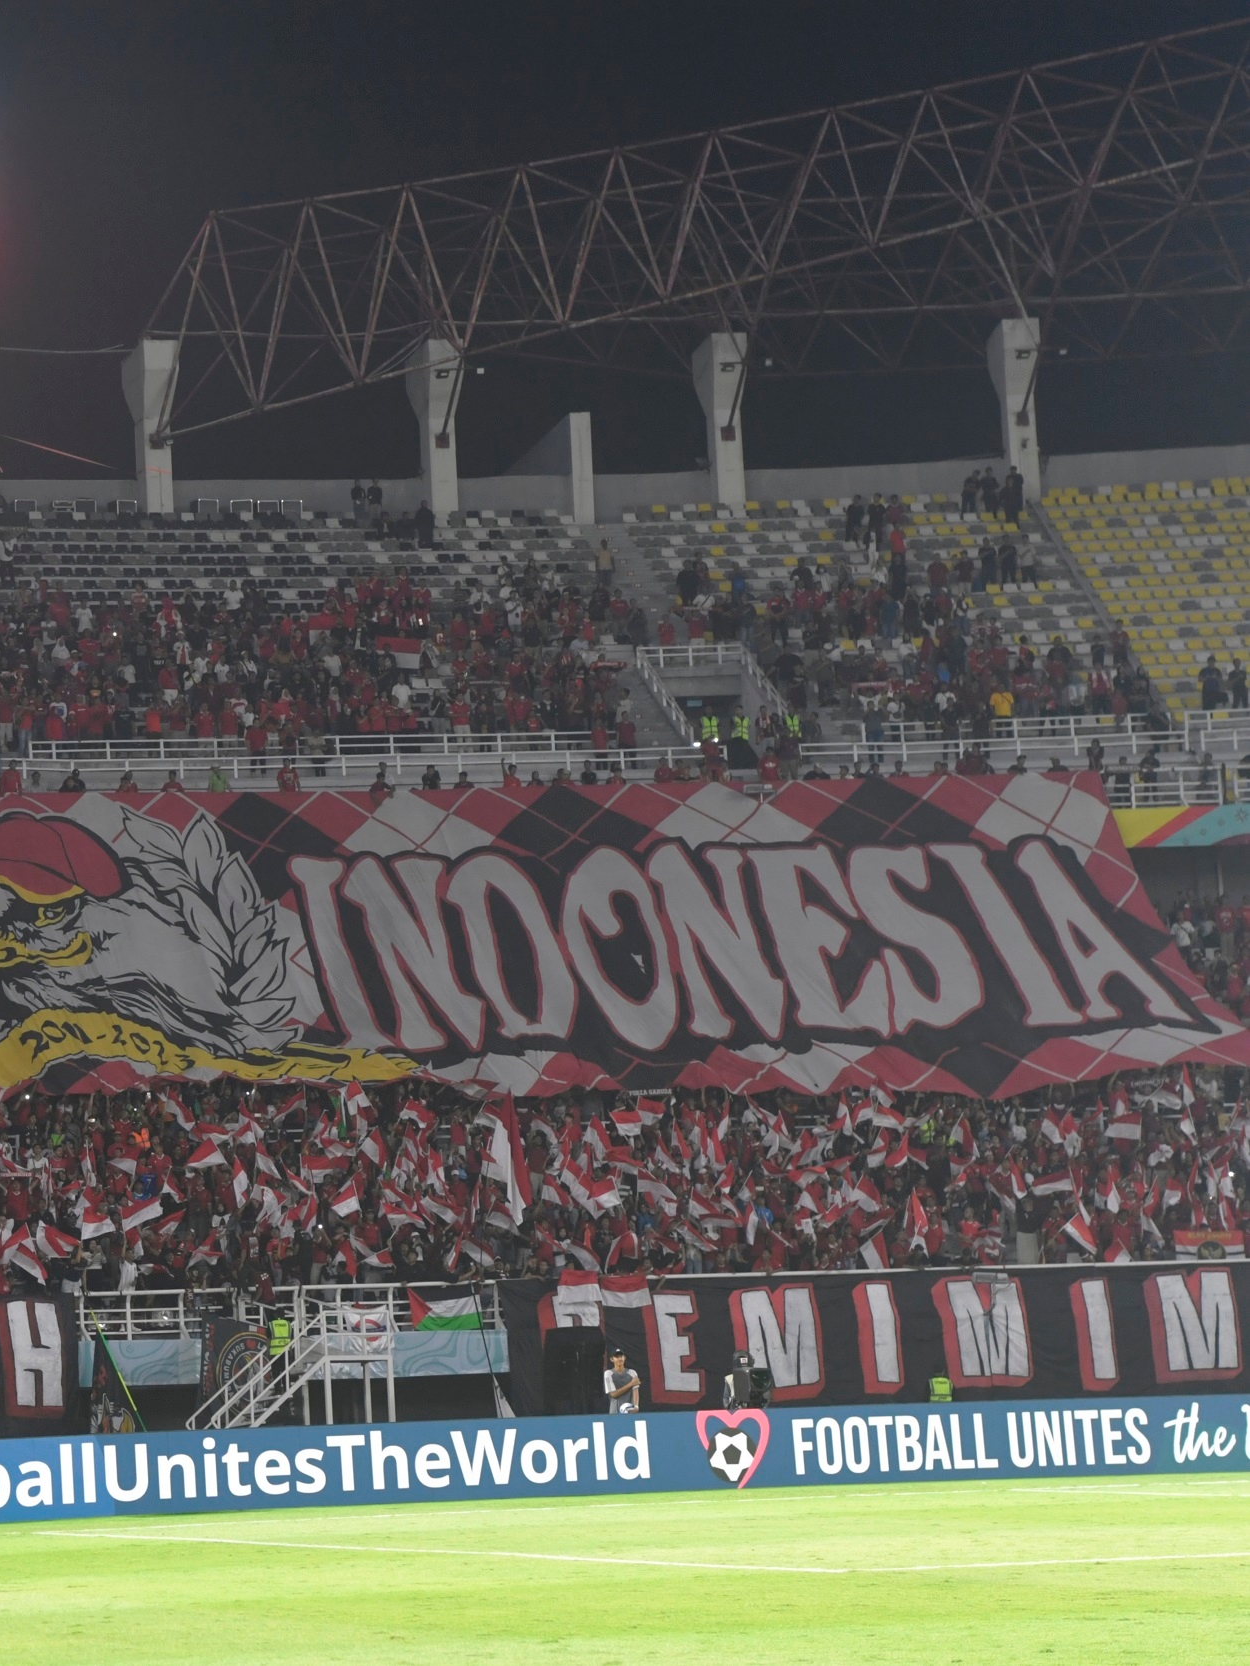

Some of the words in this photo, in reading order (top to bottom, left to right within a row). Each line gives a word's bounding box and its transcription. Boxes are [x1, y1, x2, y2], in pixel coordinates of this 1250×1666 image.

[288, 839, 1202, 1053] INDONESIA
[792, 1412, 999, 1475] FOOTBALL
[1007, 1408, 1151, 1468] UNITES
[1163, 1402, 1237, 1464] the
